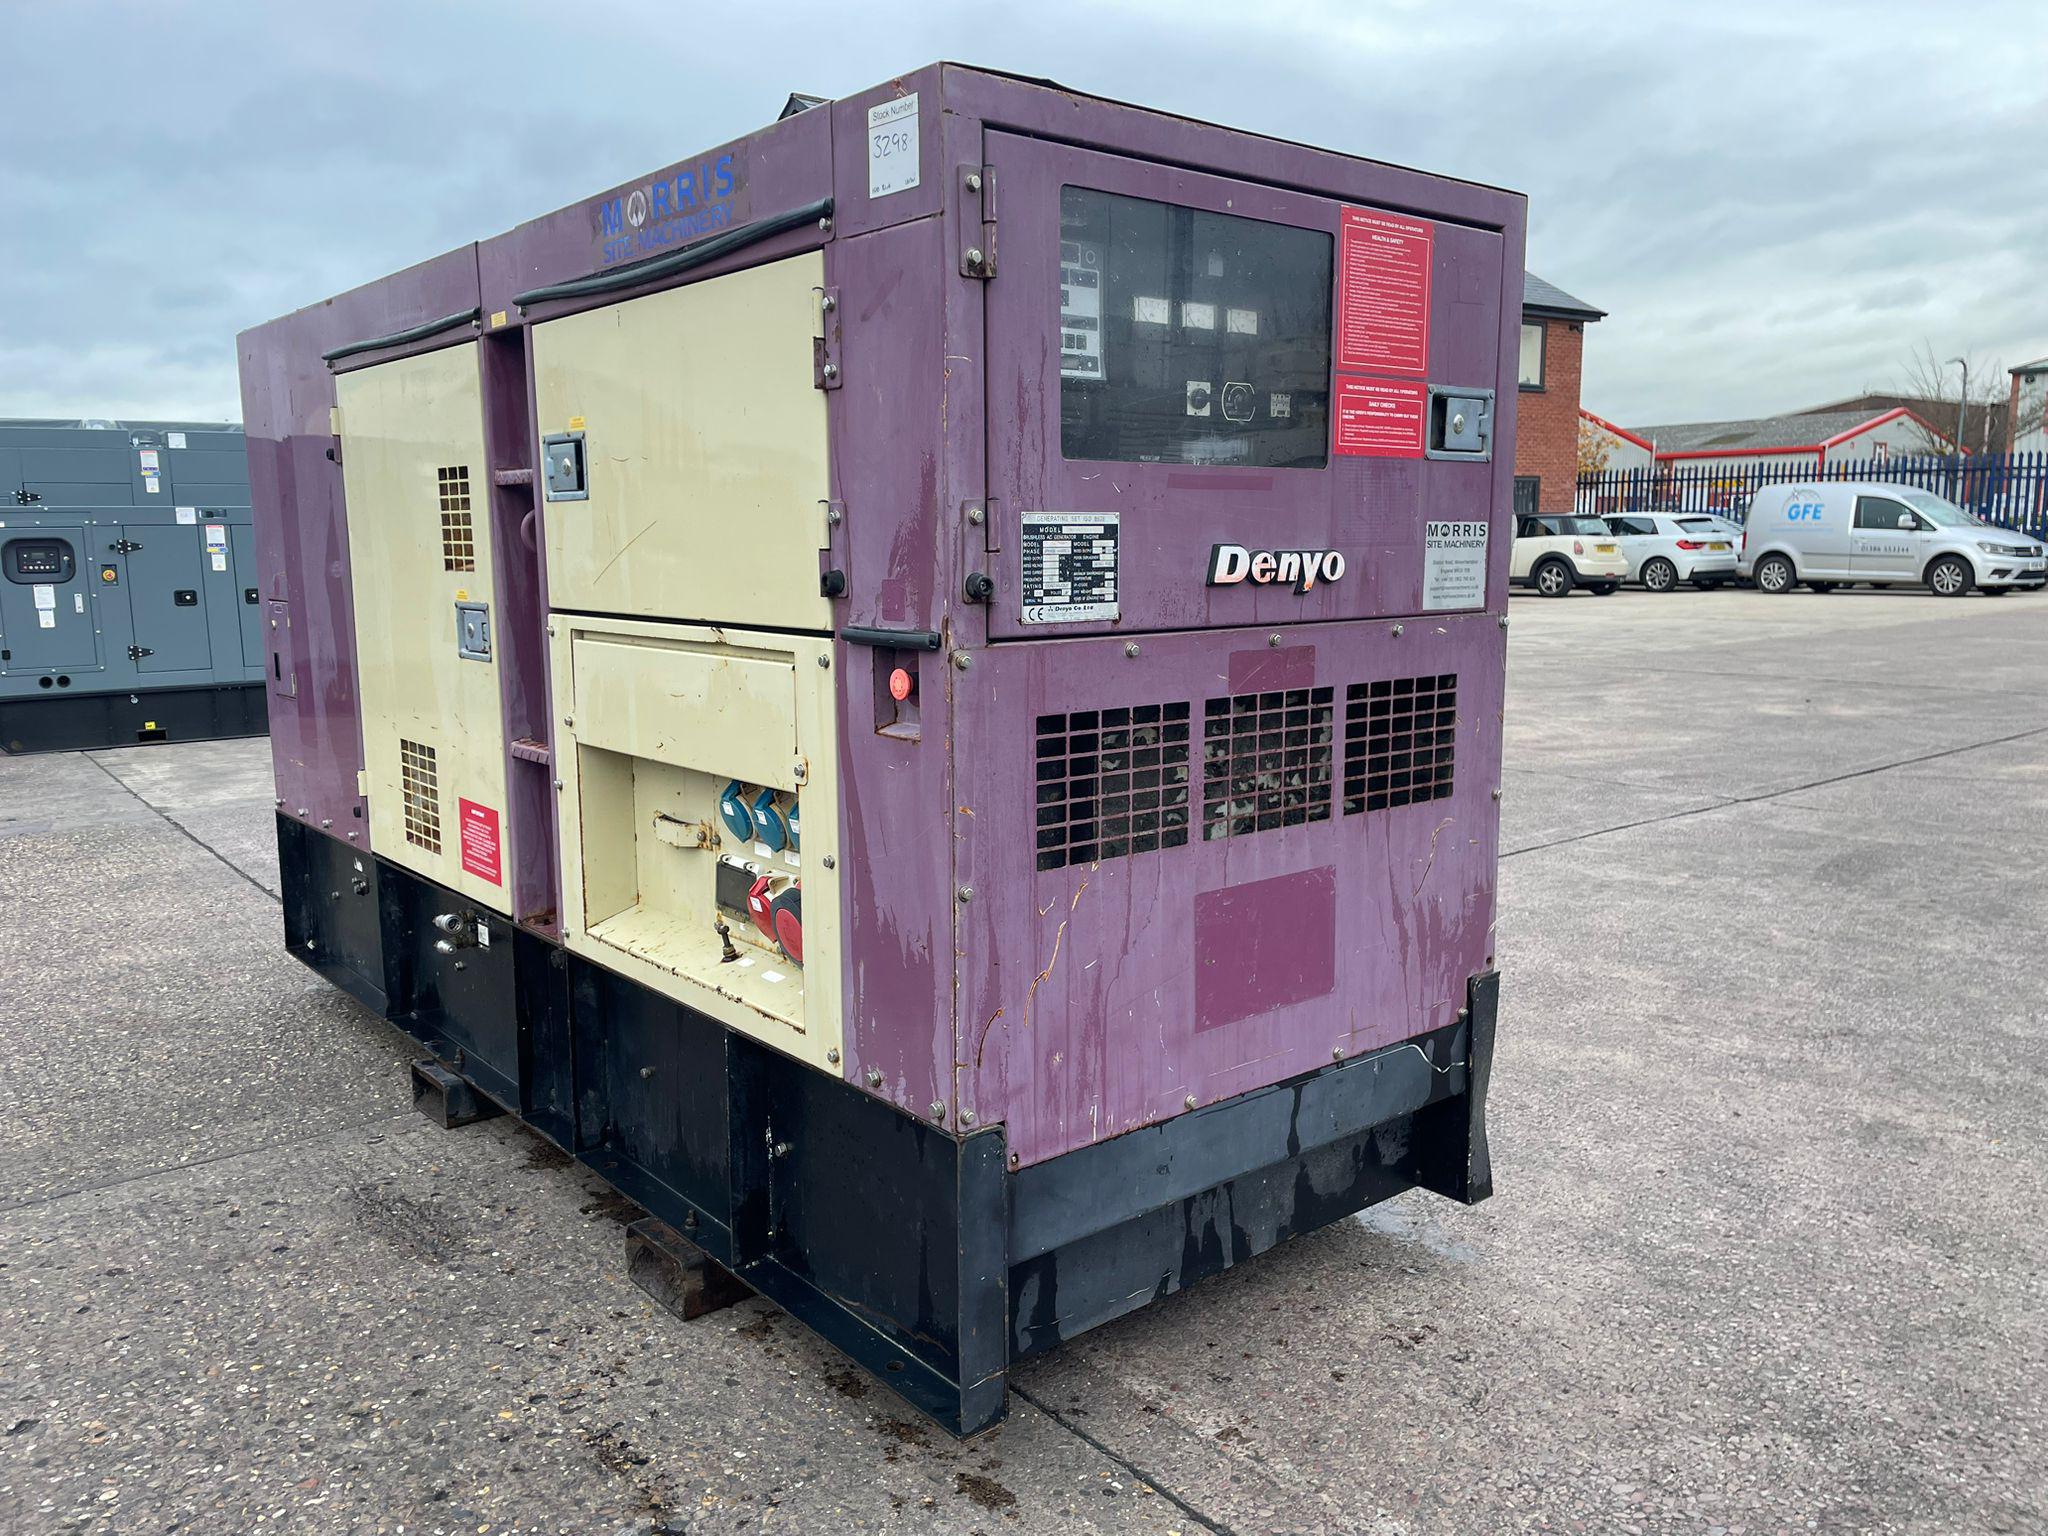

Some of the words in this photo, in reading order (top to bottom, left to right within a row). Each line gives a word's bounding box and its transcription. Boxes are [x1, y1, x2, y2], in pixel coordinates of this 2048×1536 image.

[872, 110, 890, 122] Stock
[890, 101, 914, 115] Number
[873, 133, 908, 159] 3298
[600, 155, 735, 237] MORRIS
[1788, 503, 1825, 521] GFE
[1427, 524, 1486, 537] MORRIS
[1427, 540, 1443, 548] SITE
[1444, 540, 1485, 548] MACHINERY
[1206, 543, 1345, 595] Denyo
